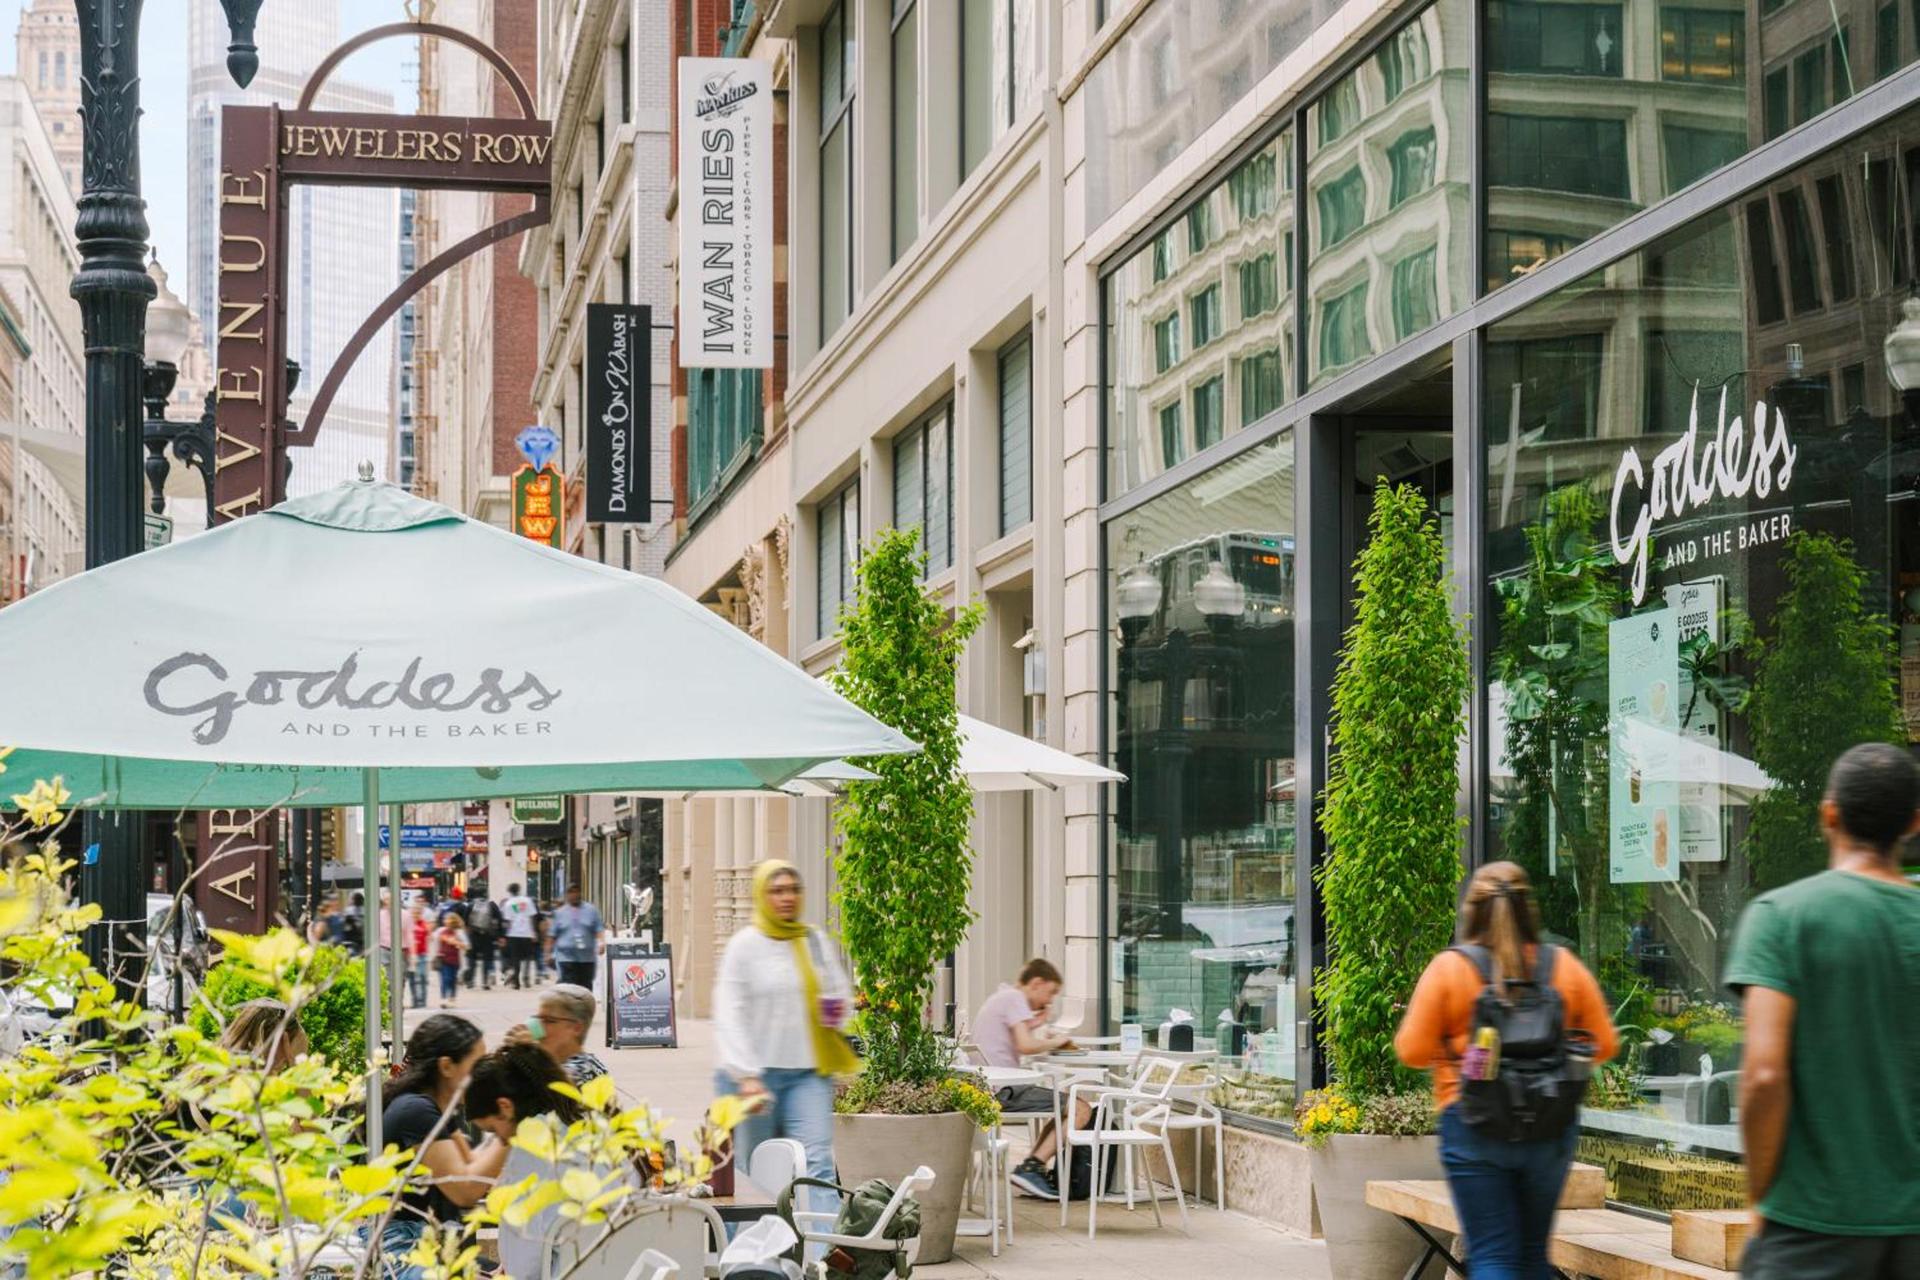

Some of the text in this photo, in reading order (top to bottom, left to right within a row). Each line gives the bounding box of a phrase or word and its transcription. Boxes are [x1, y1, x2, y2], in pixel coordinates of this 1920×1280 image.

[281, 124, 552, 165] JEWELERS ROW
[702, 128, 734, 353] IWAN RIES
[215, 171, 266, 527] AVENUE
[605, 313, 630, 390] WABASH
[609, 429, 626, 513] DIAMONDS
[1610, 378, 1797, 606] Goddess
[1665, 514, 1791, 569] AND THE BAKER
[1683, 611, 1709, 627] GODDESS
[143, 648, 562, 745] Goddess
[281, 721, 553, 738] AND THE BAKER
[1676, 1183, 1704, 1209] COFFEE
